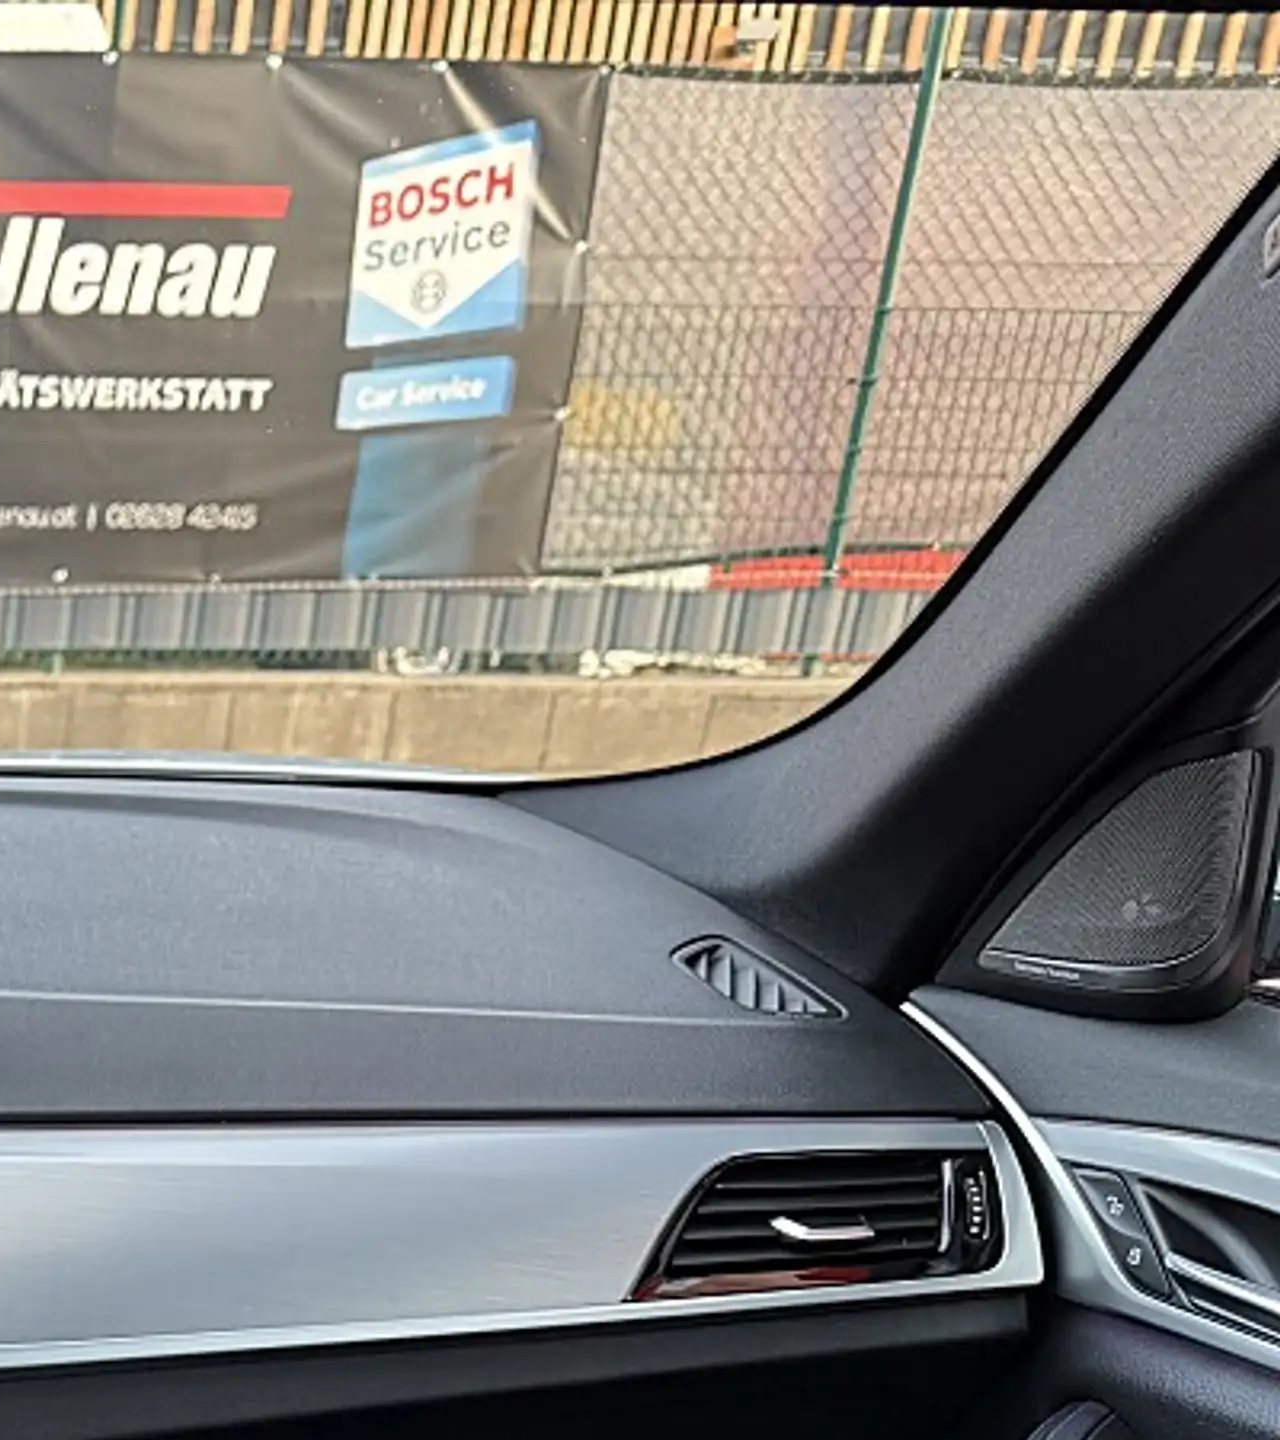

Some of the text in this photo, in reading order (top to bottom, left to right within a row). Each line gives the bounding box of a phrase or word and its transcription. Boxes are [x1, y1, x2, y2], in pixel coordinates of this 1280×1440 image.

[367, 163, 516, 230] BOSCH
[362, 220, 511, 272] Service
[355, 377, 487, 411] Car Service
